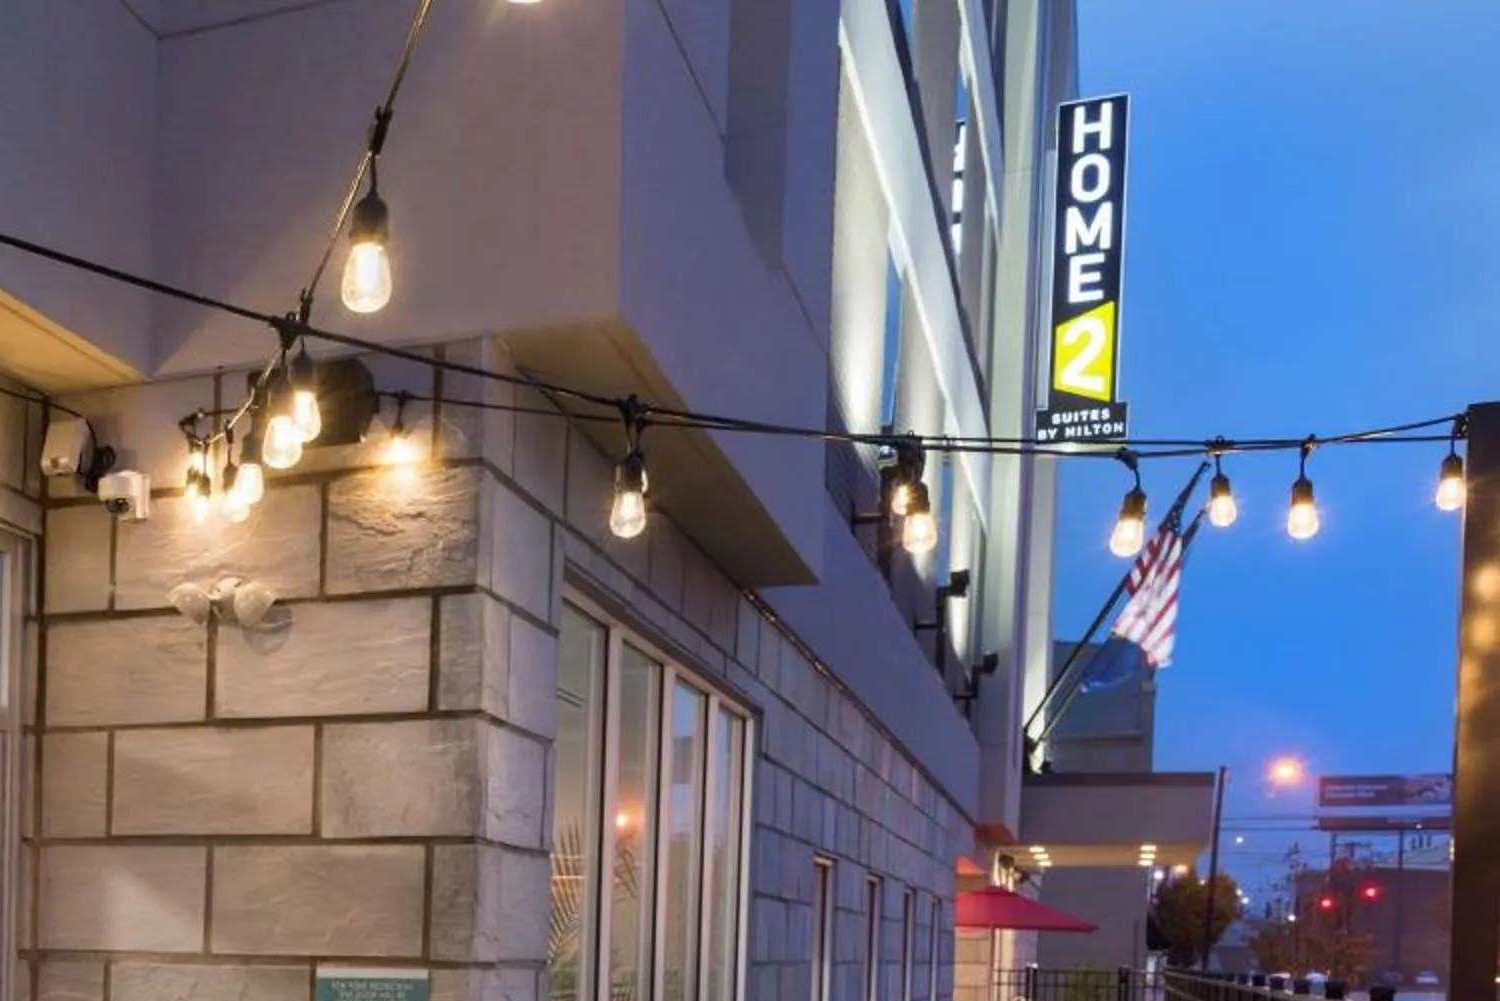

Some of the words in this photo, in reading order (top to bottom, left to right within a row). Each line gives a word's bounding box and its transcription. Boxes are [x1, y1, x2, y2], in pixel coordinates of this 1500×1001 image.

[1063, 101, 1113, 304] HOME
[1059, 316, 1107, 393] 2
[1037, 428, 1057, 441] BY
[1064, 421, 1124, 438] HILTON
[1051, 408, 1111, 425] SUITES
